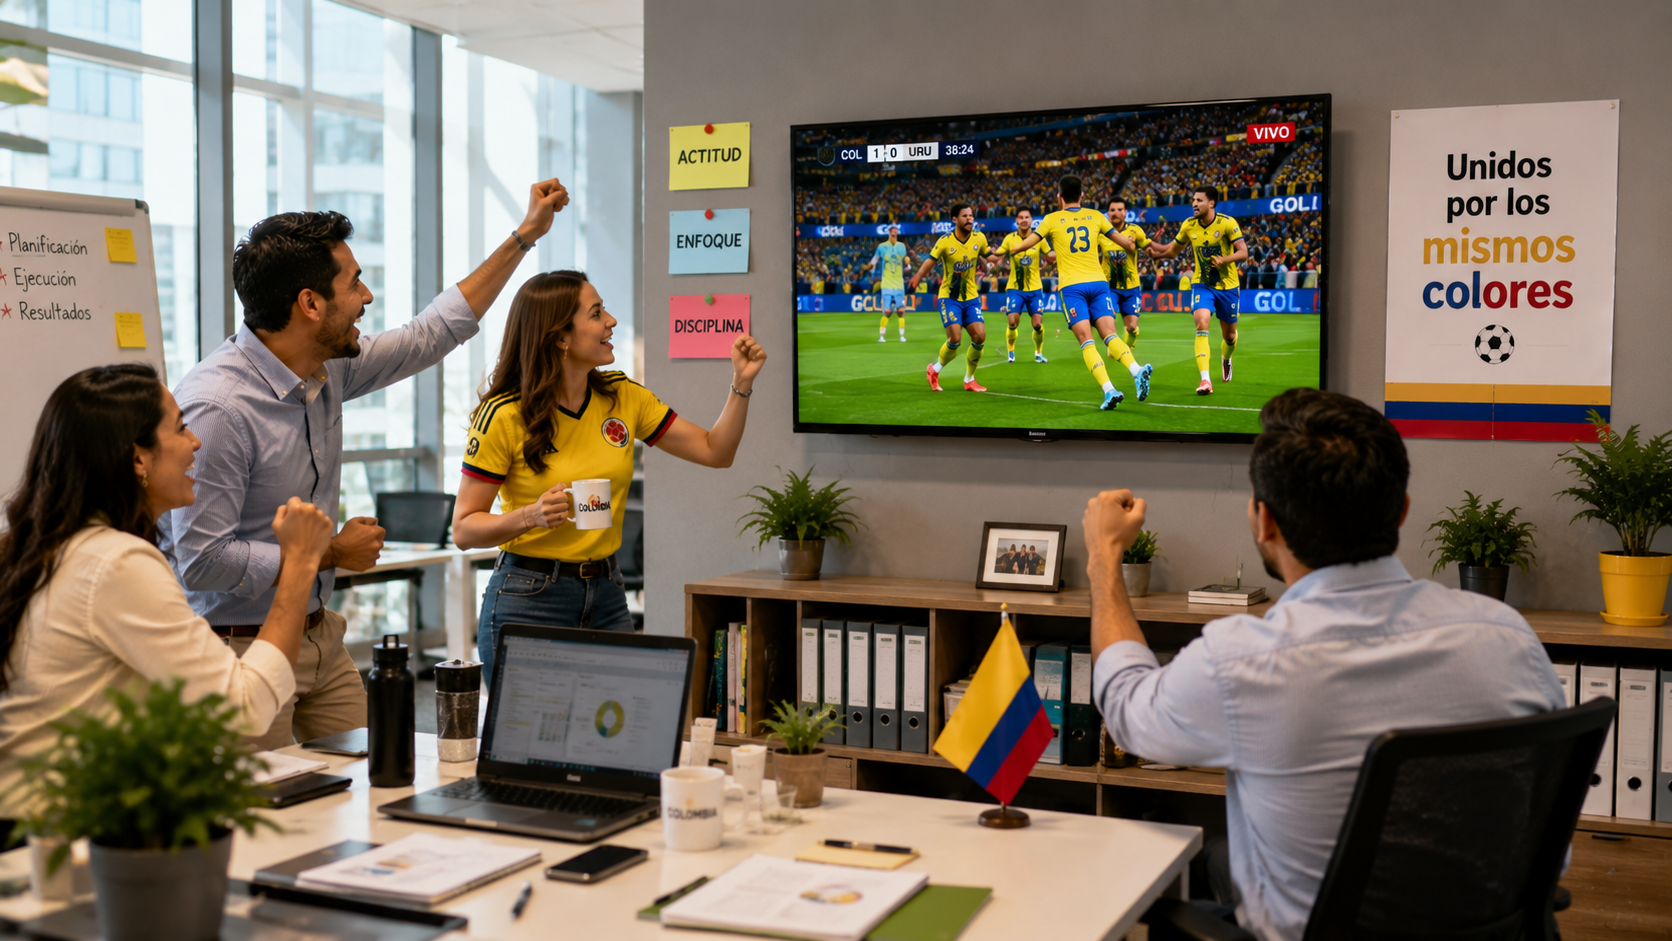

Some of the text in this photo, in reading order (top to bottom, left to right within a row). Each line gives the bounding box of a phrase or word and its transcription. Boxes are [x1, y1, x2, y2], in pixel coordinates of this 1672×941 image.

[1253, 126, 1290, 140] VIVO
[678, 147, 742, 165] ACTITUD
[841, 144, 974, 160] COL 1 0 URU 38:24
[1447, 150, 1552, 181] Unidos
[1447, 187, 1550, 223] por los
[8, 232, 88, 255] Planificación
[676, 233, 742, 250] ENFOQUE
[1067, 226, 1090, 253] 23
[1423, 226, 1576, 265] mismos
[13, 267, 77, 293] Ejecución
[1422, 271, 1574, 309] colores
[19, 301, 92, 321] Resultados
[1254, 291, 1301, 312] GOL
[674, 319, 744, 334] DISCIPLINA
[667, 807, 717, 820] COLOMBIA
